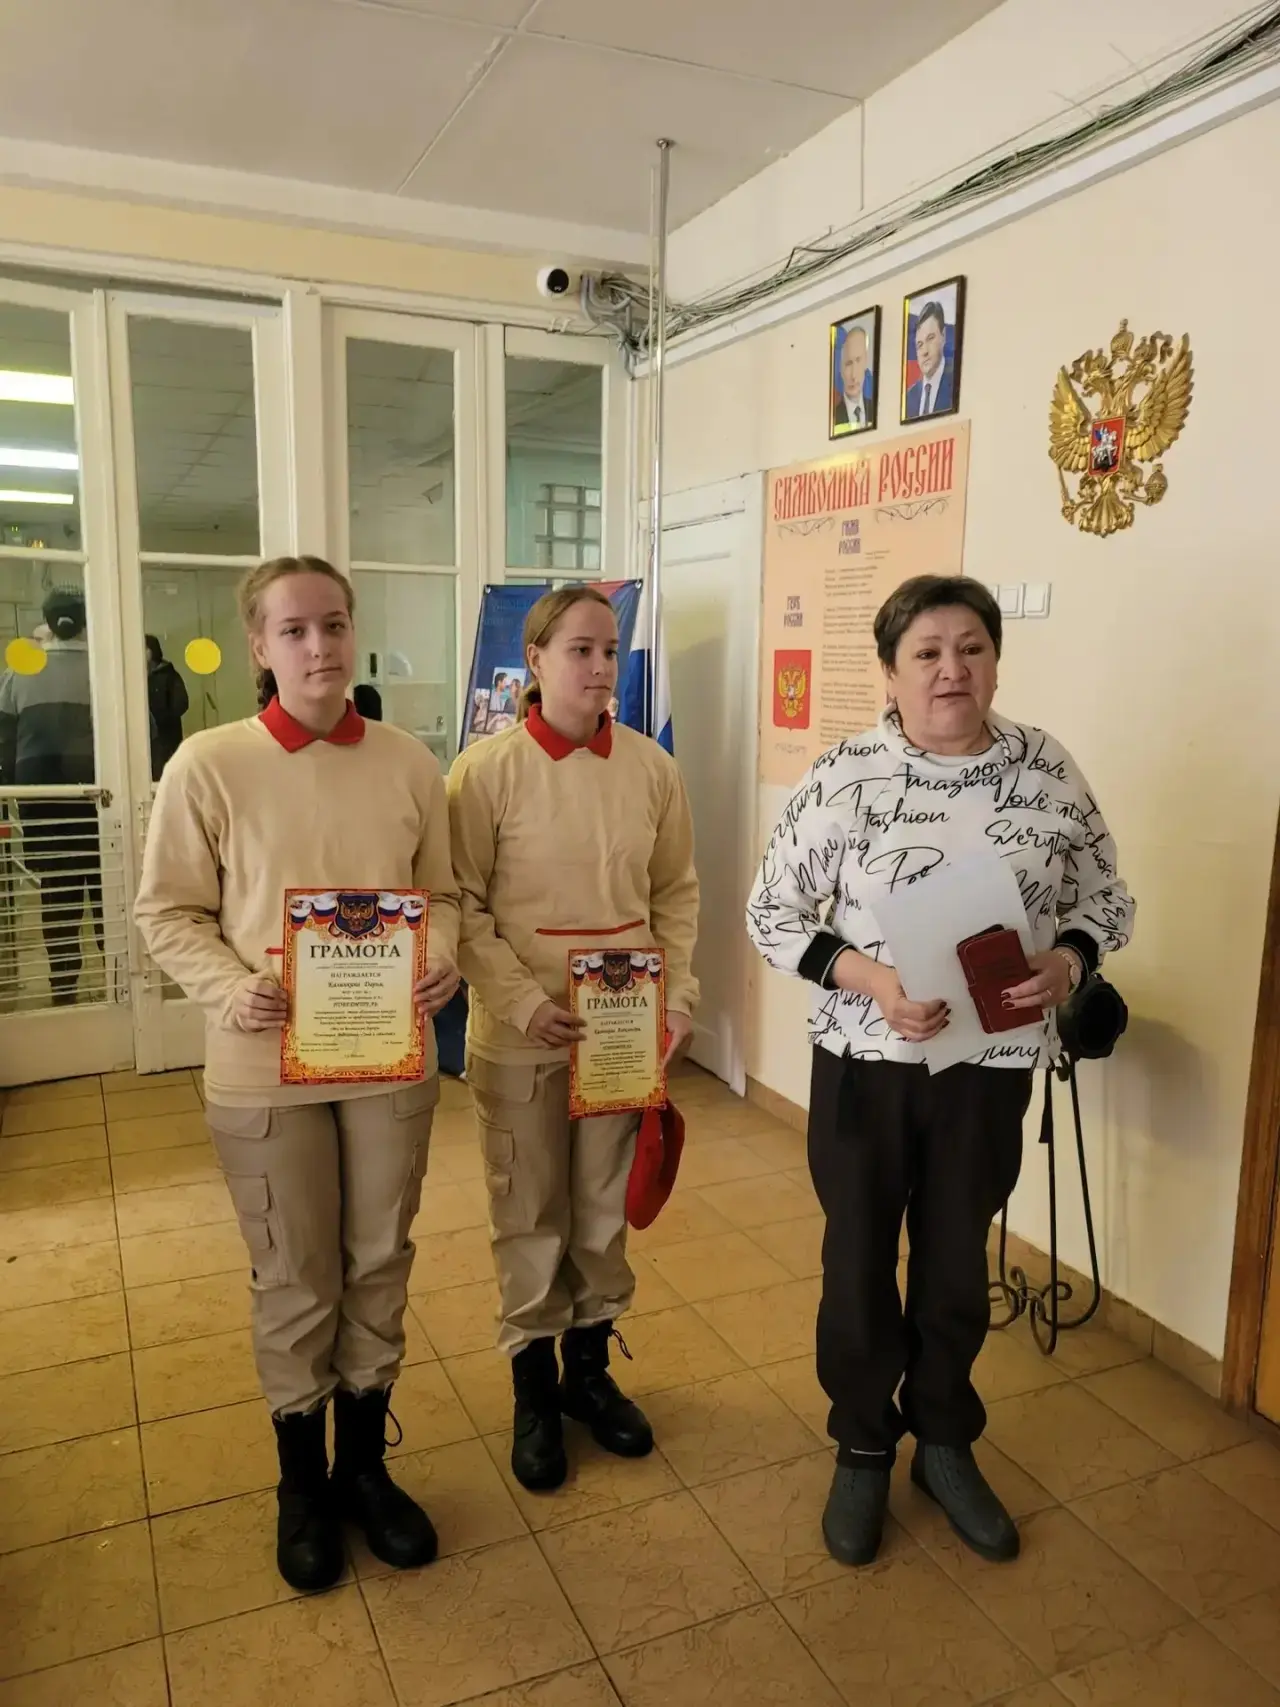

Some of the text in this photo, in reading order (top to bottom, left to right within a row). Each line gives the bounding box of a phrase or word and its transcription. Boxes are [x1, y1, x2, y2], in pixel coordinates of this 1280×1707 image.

[774, 438, 955, 521] СИМВОЛИКА РОССИИ
[309, 944, 401, 959] ГРАМОТА
[586, 996, 648, 1010] ГРАМОТА
